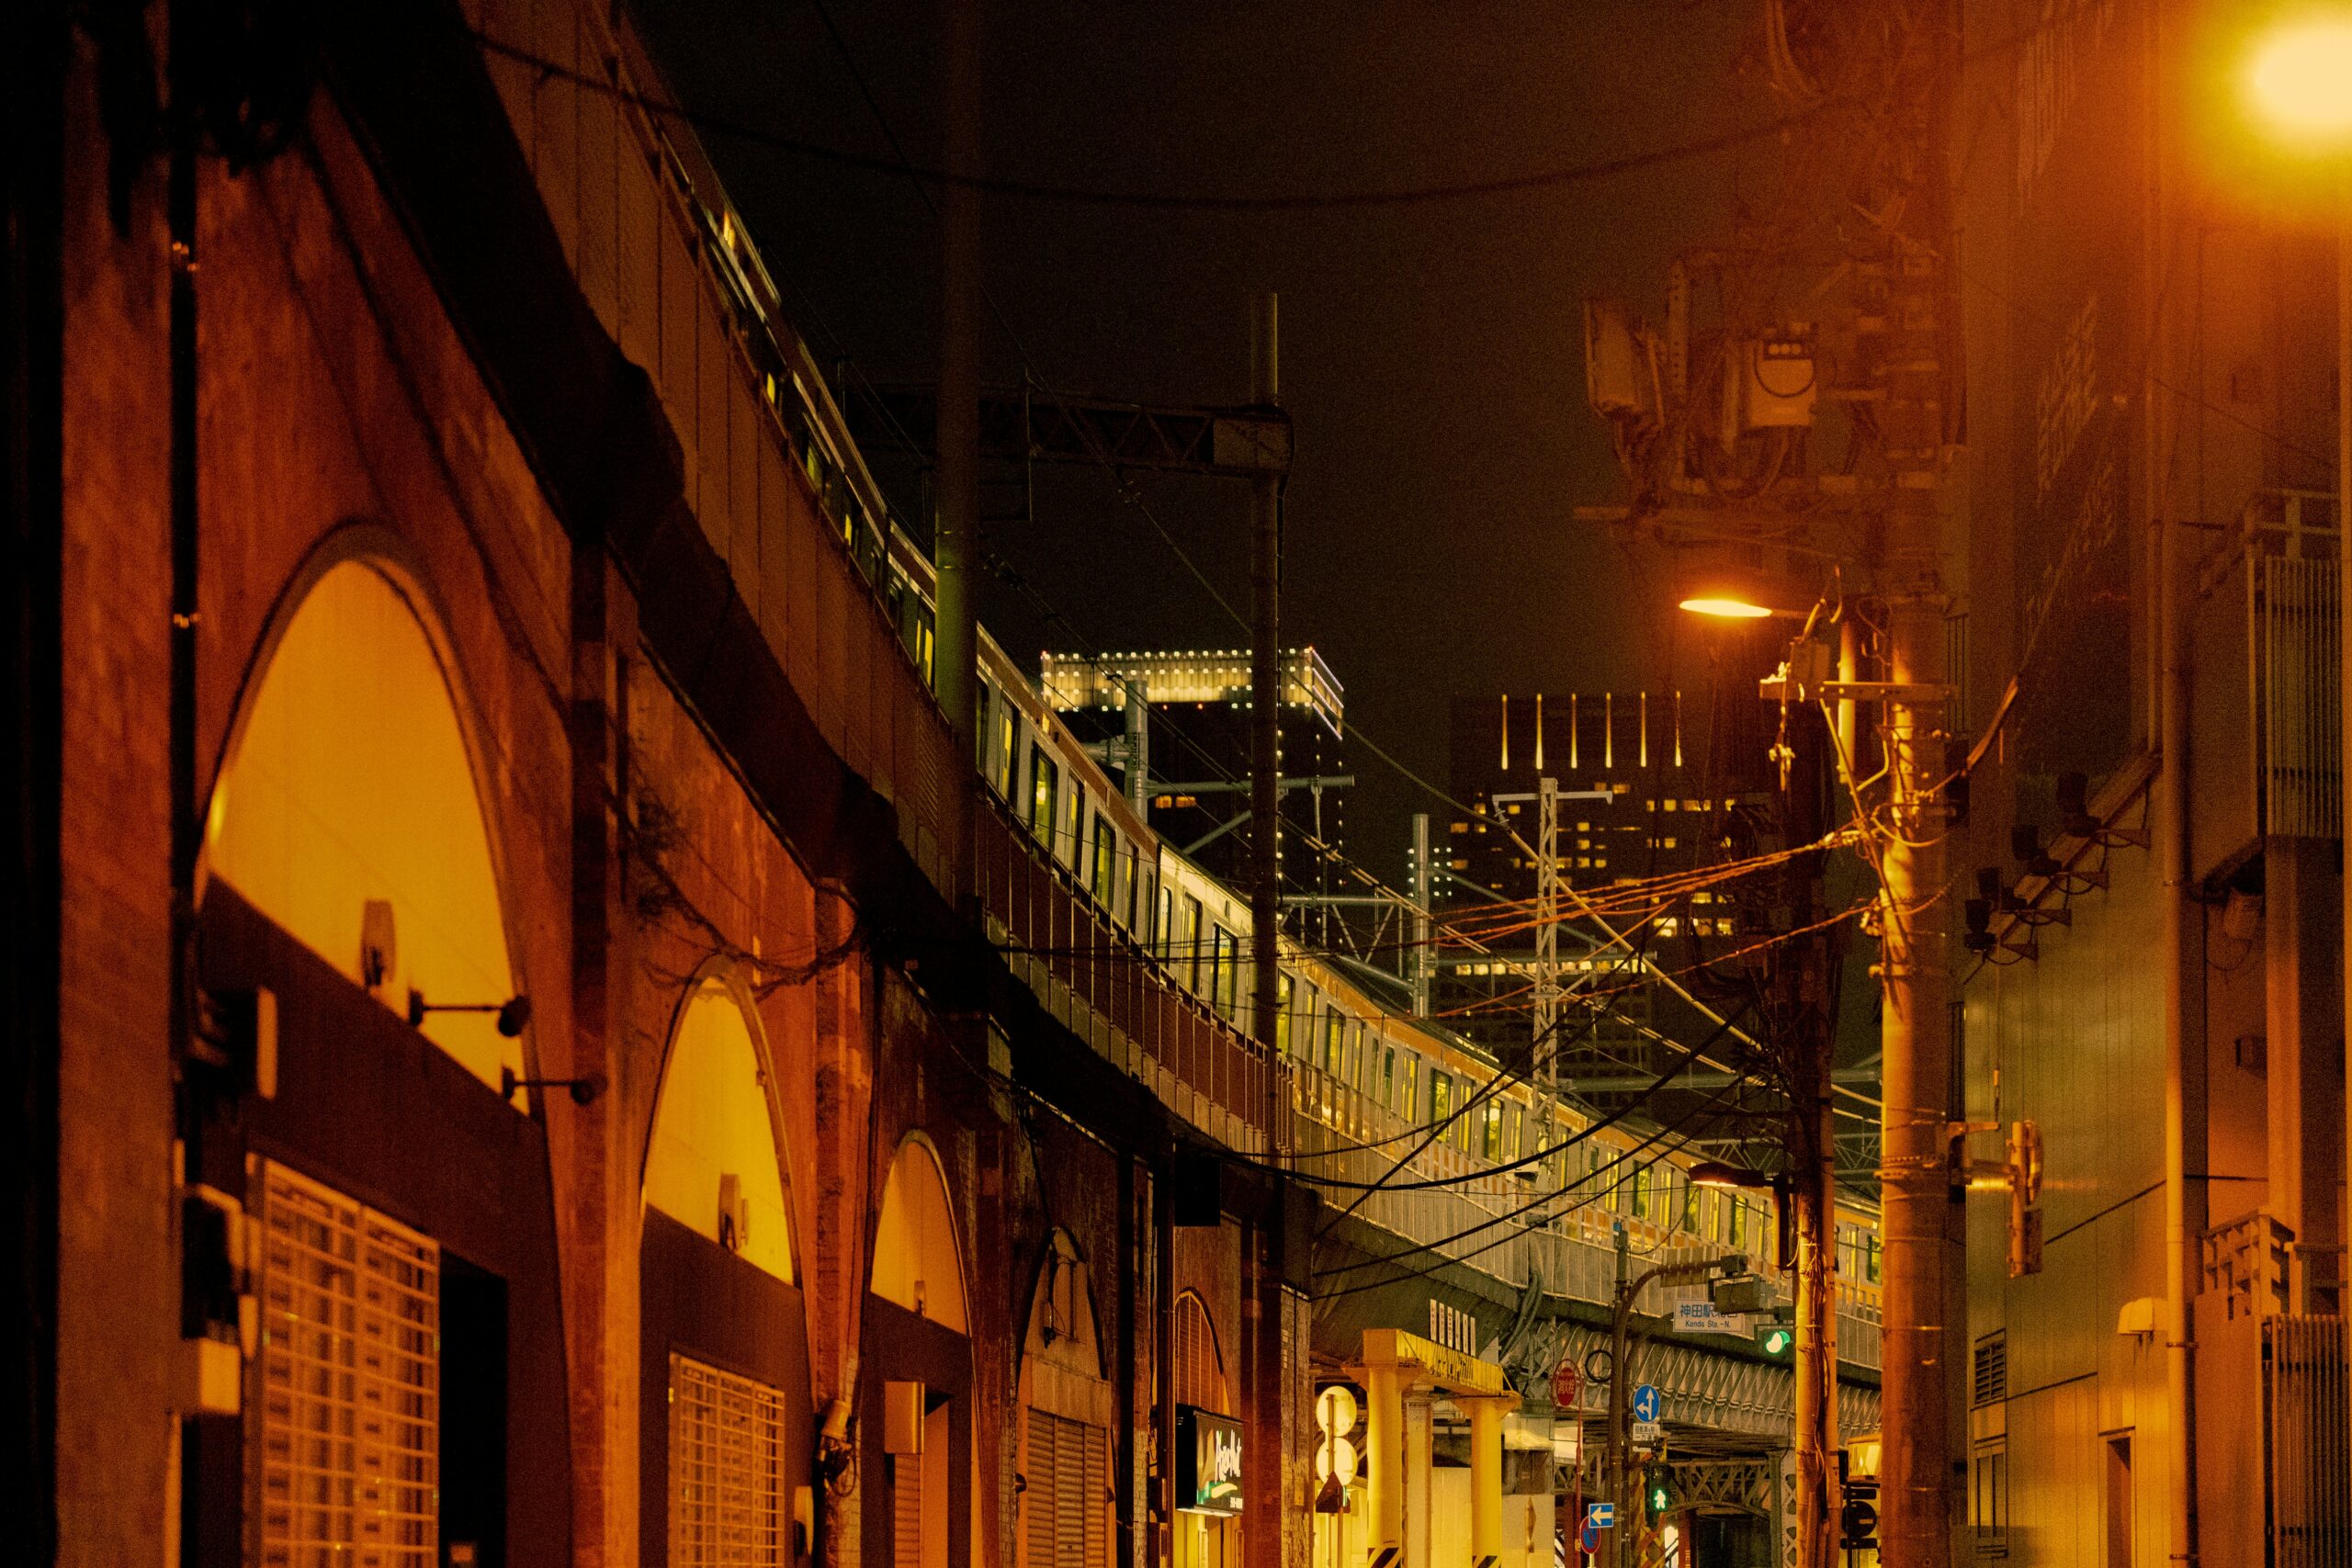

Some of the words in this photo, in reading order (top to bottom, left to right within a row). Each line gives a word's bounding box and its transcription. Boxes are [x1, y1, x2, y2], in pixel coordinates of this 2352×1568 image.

[1680, 1304, 1737, 1318] 神田駅
[1685, 1320, 1705, 1328] Kanda
